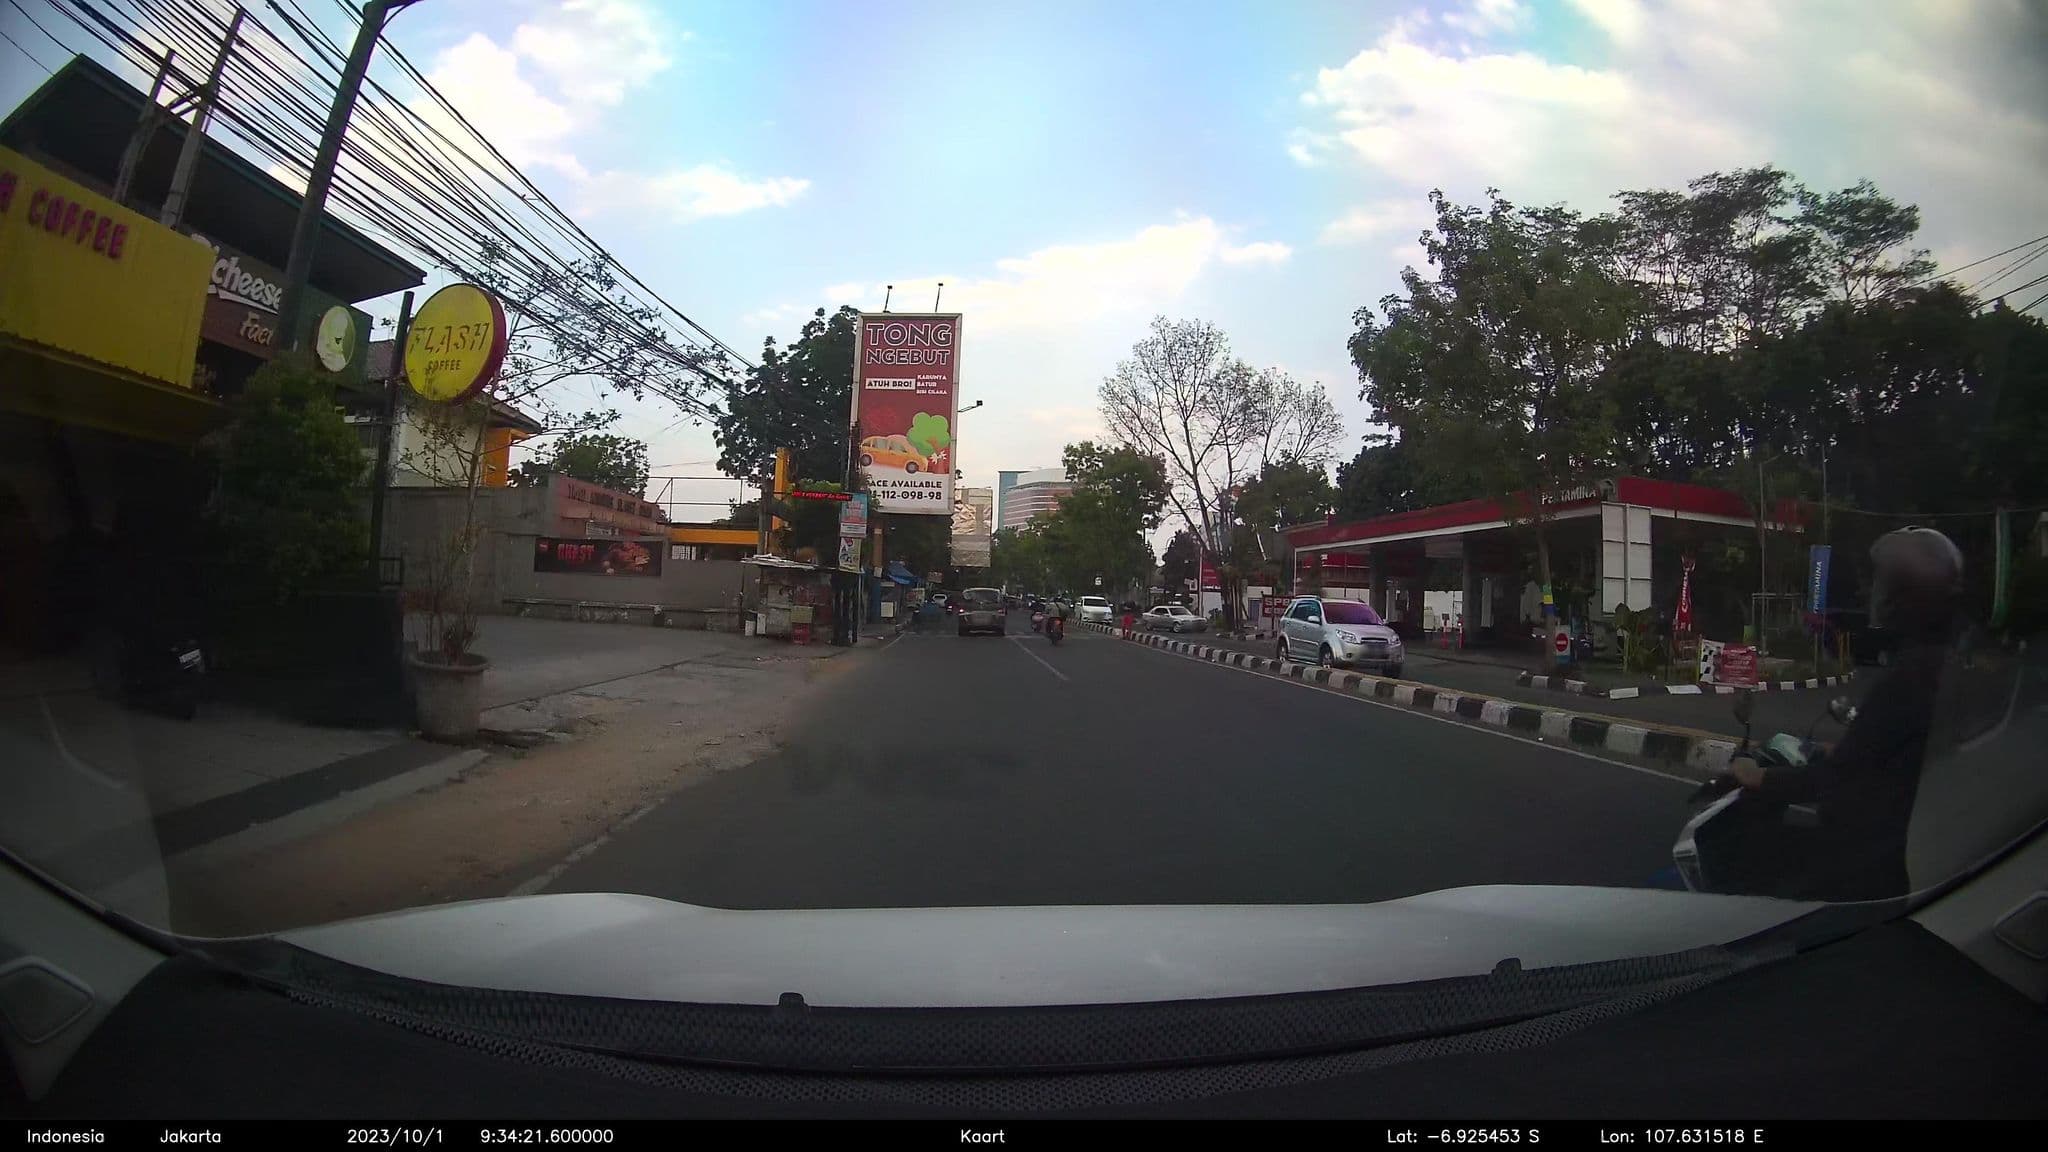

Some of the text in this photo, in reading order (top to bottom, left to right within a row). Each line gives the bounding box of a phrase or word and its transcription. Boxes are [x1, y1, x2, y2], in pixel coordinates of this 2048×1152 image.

[28, 187, 129, 260] COFFEE
[409, 322, 490, 354] FLASH
[866, 323, 952, 347] TONG
[427, 359, 462, 373] COFFEE
[866, 348, 951, 366] NGEBUT
[867, 379, 912, 388] ATUH BRO!
[890, 481, 942, 489] AVAILABLE
